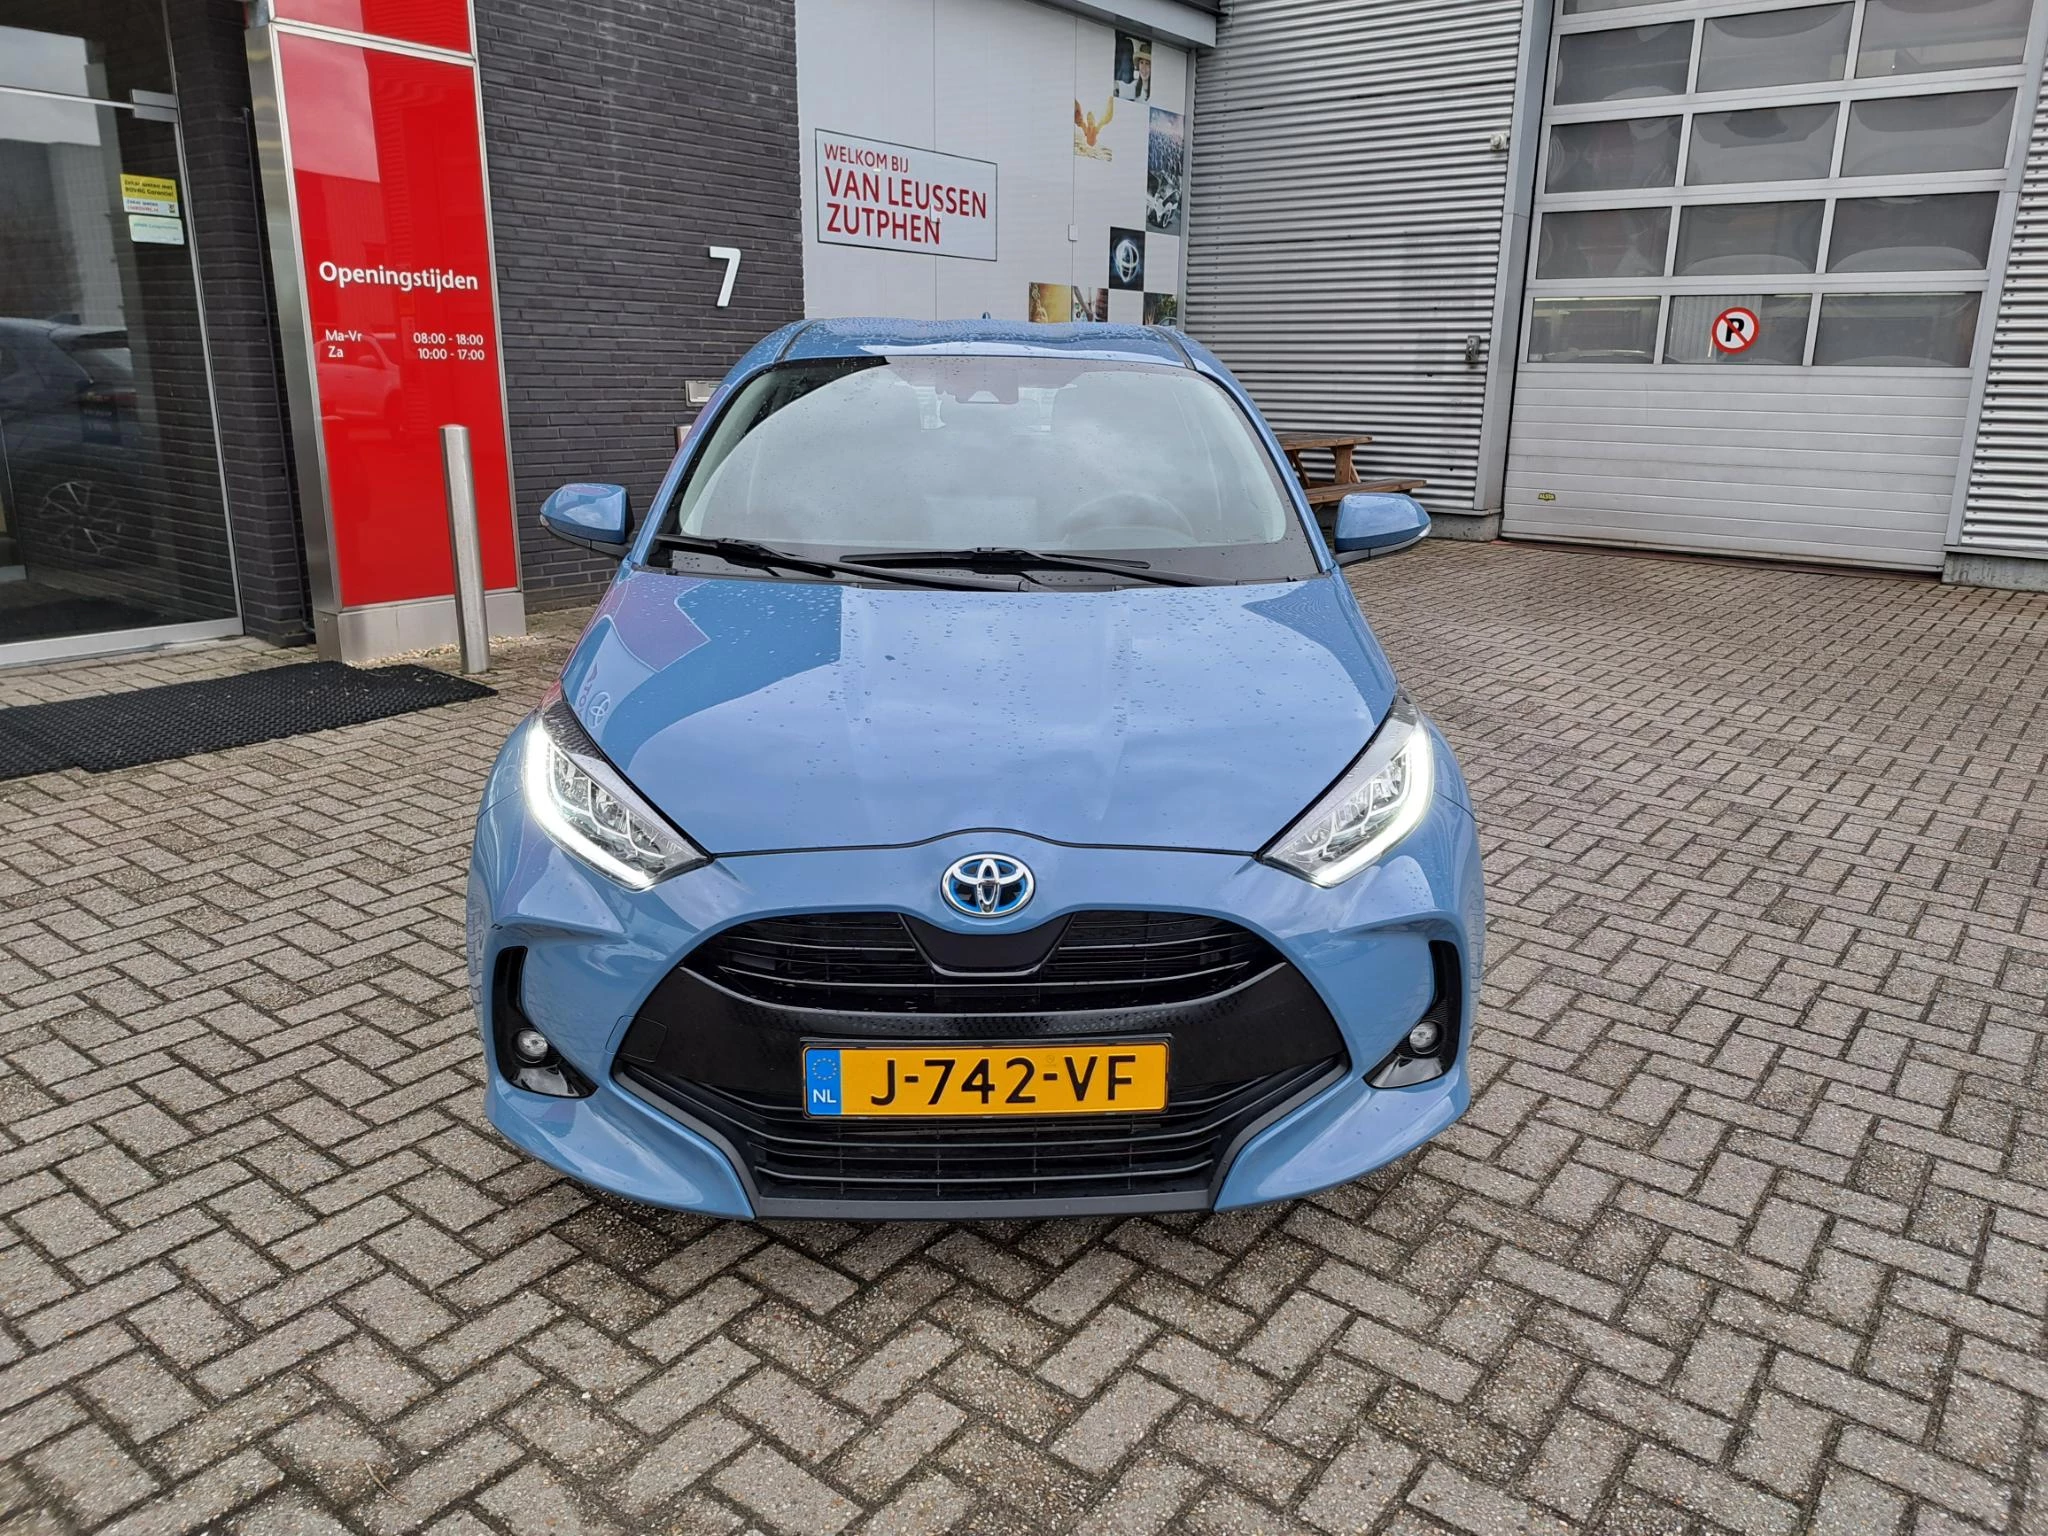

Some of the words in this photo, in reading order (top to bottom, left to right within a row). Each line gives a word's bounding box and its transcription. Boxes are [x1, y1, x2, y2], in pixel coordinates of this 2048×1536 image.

[824, 143, 887, 169] WELKOM
[891, 156, 909, 173] BIJ
[824, 166, 880, 203] VAN
[888, 176, 987, 219] LEUSSEN
[826, 202, 941, 245] ZUTPHEN
[319, 261, 479, 293] Openingstijden
[709, 246, 741, 307] 7
[325, 329, 363, 342] Ma-Vr
[413, 333, 446, 345] 08:00
[456, 334, 483, 346] 18:00
[328, 345, 344, 358] Za
[418, 348, 447, 360] 10:00
[457, 349, 485, 361] 17:00
[812, 1089, 837, 1104] NL
[870, 1055, 1137, 1106] J-742-VF
